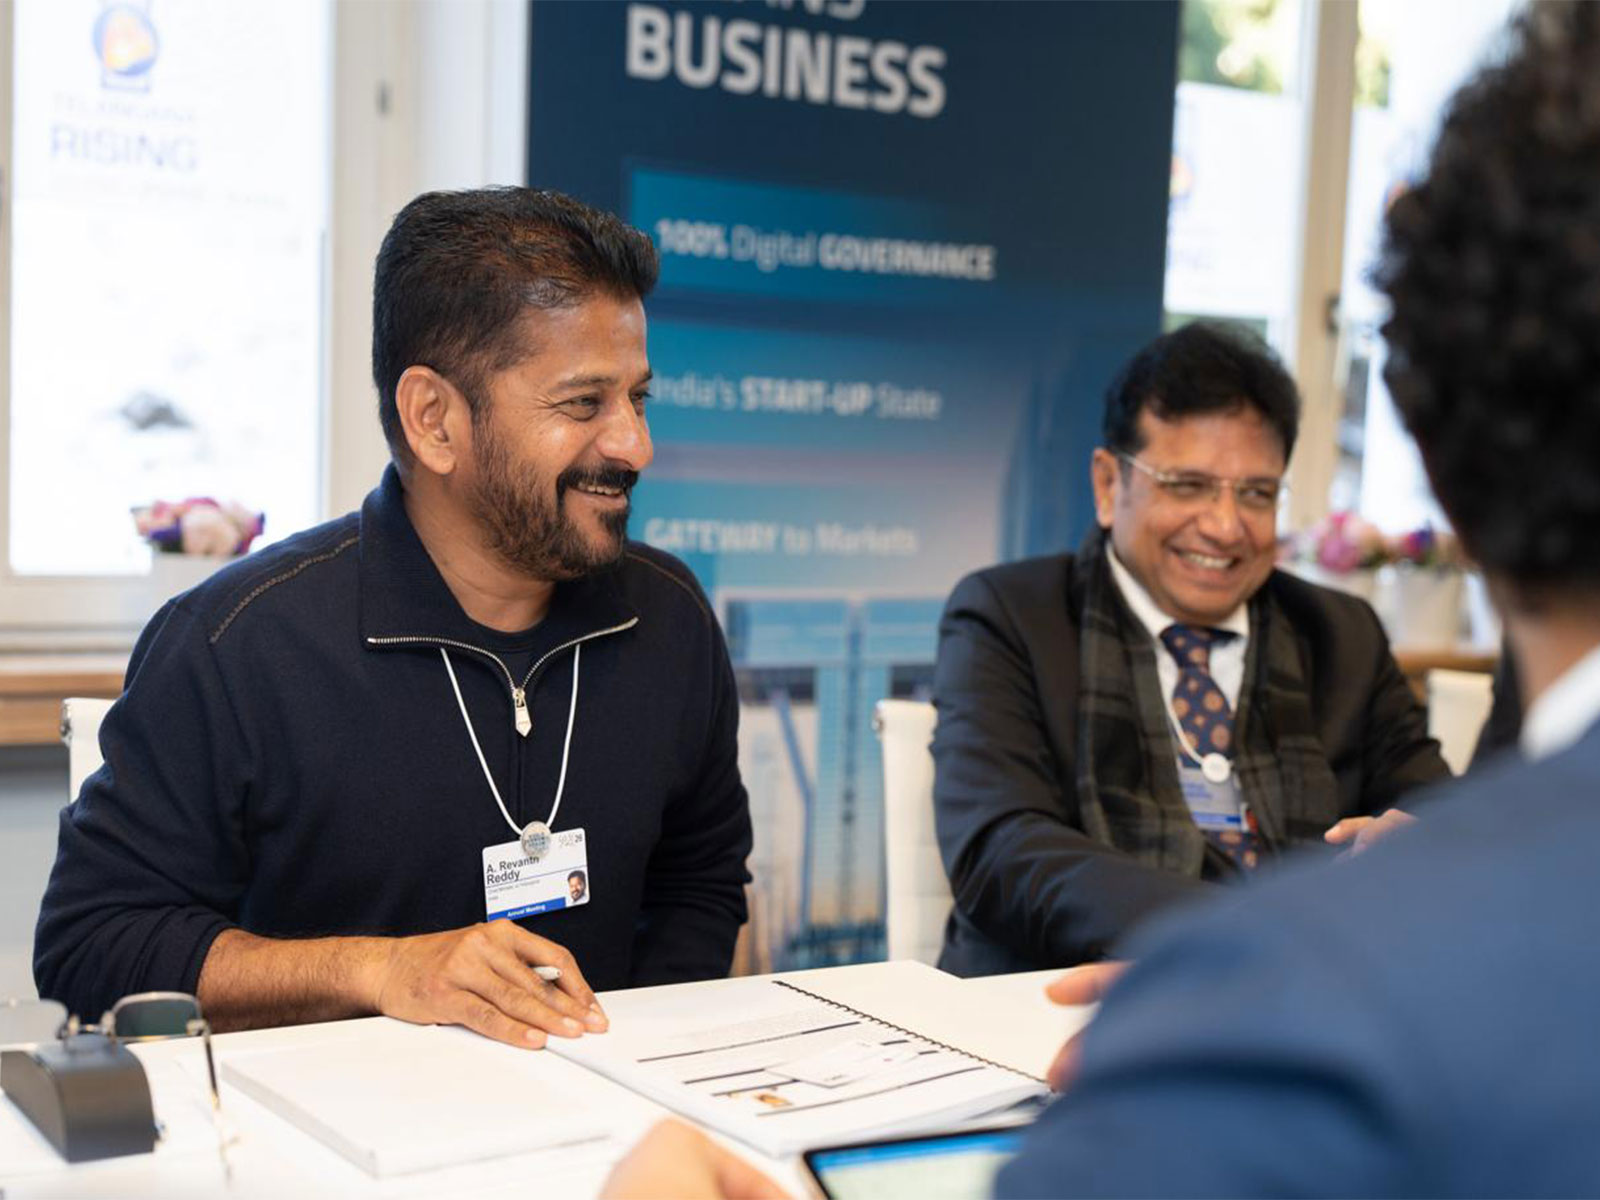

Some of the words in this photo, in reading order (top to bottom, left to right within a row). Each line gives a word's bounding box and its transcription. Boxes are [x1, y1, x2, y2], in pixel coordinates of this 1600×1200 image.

[625, 4, 948, 118] BUSINESS
[49, 122, 199, 173] RISING
[657, 218, 729, 259] 100%
[731, 226, 818, 273] Digital
[818, 233, 996, 280] GOVERNANCE
[740, 376, 872, 416] START-UP
[875, 383, 942, 421] State
[644, 518, 779, 554] GATEWAY
[782, 525, 814, 555] to
[816, 522, 919, 556] Markets
[486, 864, 497, 874] A.
[486, 870, 520, 886] Reddy
